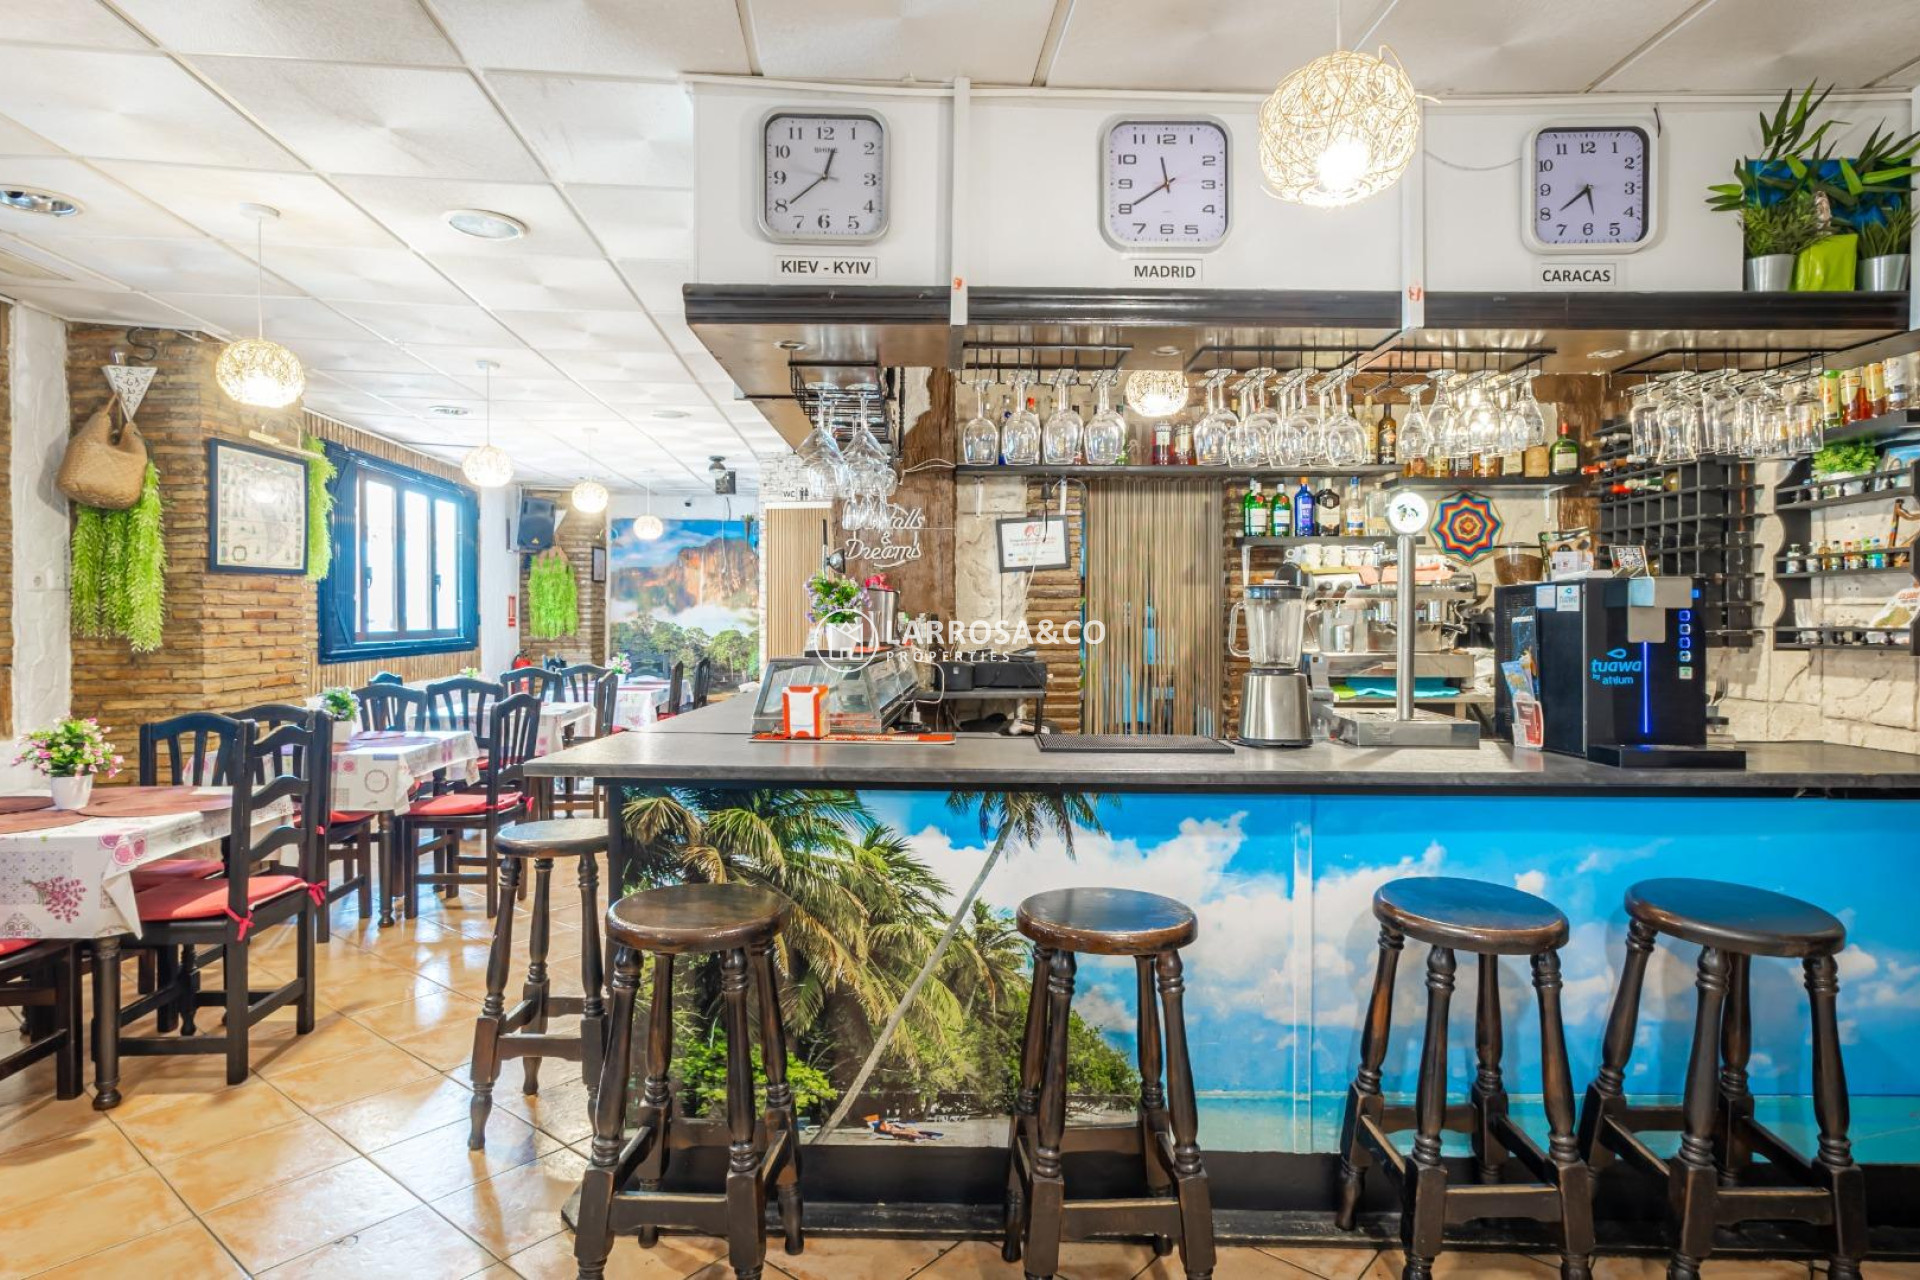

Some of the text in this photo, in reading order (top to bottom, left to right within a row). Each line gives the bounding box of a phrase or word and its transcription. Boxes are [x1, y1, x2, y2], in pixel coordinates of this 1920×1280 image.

[789, 127, 802, 140] 11
[817, 127, 835, 140] 12
[851, 127, 856, 140] 1
[1133, 134, 1145, 144] 11
[1157, 134, 1177, 145] 12
[1189, 134, 1194, 144] 1
[775, 145, 790, 159] 10
[864, 142, 875, 155] 2
[1556, 143, 1567, 155] 11
[1580, 142, 1596, 154] 12
[1611, 142, 1618, 153] 1
[1118, 154, 1137, 165] 10
[1202, 155, 1216, 166] 2
[1624, 157, 1635, 170] 2
[1539, 160, 1553, 172] 10
[774, 171, 787, 185] 9
[864, 173, 876, 187] 3
[1118, 179, 1133, 189] 9
[1201, 180, 1216, 190] 3
[1540, 184, 1551, 196] 9
[1624, 182, 1635, 195] 3
[774, 199, 788, 213] 8
[863, 200, 875, 213] 4
[1118, 203, 1132, 214] 8
[1202, 205, 1216, 214] 4
[1624, 206, 1634, 218] 4
[1540, 208, 1551, 221] 8
[793, 216, 804, 229] 7
[818, 215, 830, 229] 6
[848, 216, 859, 229] 5
[1133, 223, 1146, 234] 7
[1160, 224, 1174, 234] 6
[1184, 225, 1199, 234] 5
[1556, 224, 1567, 236] 7
[1583, 223, 1593, 235] 6
[1609, 223, 1620, 236] 5
[781, 261, 819, 274] KIEV
[834, 261, 871, 274] KYIV
[1134, 266, 1196, 278] MADRID
[1543, 270, 1611, 282] CARACAS
[845, 539, 921, 560] Dreams
[1591, 659, 1642, 672] tuawa
